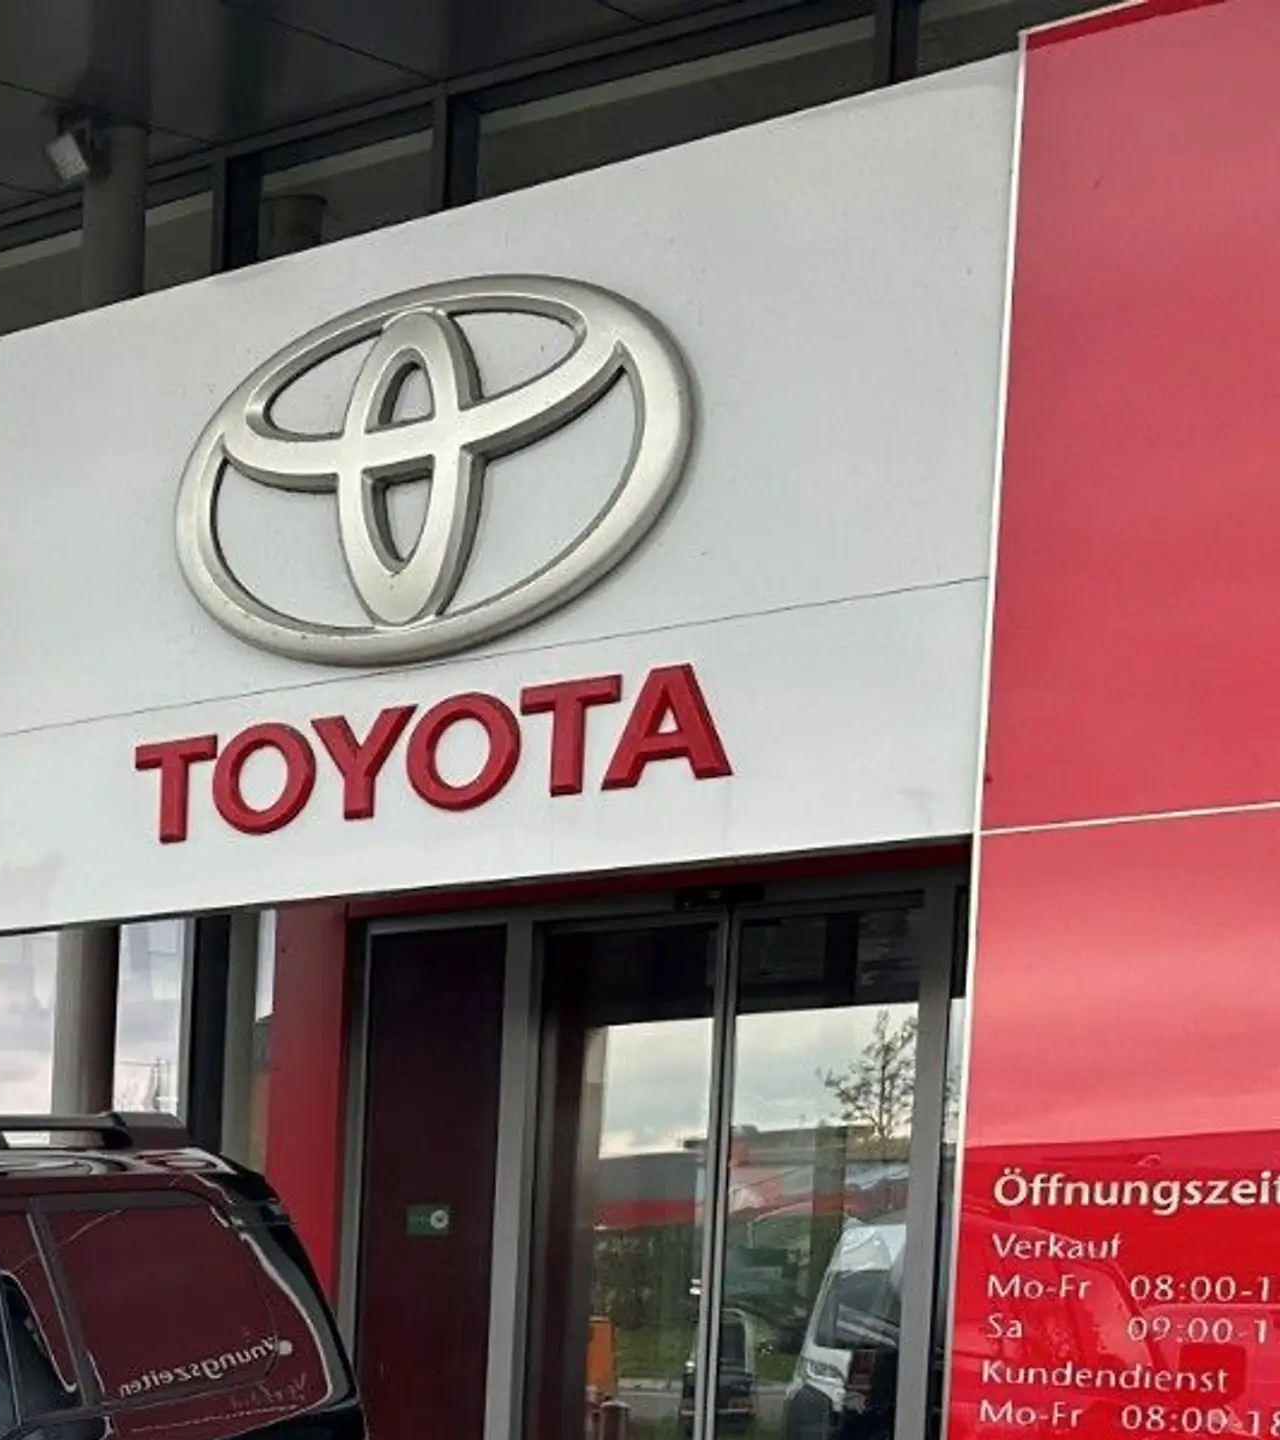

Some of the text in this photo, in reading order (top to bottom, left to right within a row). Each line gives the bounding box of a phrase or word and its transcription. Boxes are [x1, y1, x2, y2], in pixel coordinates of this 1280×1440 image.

[134, 662, 733, 844] TOYOTA
[991, 1231, 1123, 1259] Verkauf
[987, 1273, 1091, 1300] Mo-Fr
[986, 1312, 1024, 1339] Sa
[981, 1360, 1230, 1393] Kundendienst
[978, 1399, 1085, 1427] Mo-Fr
